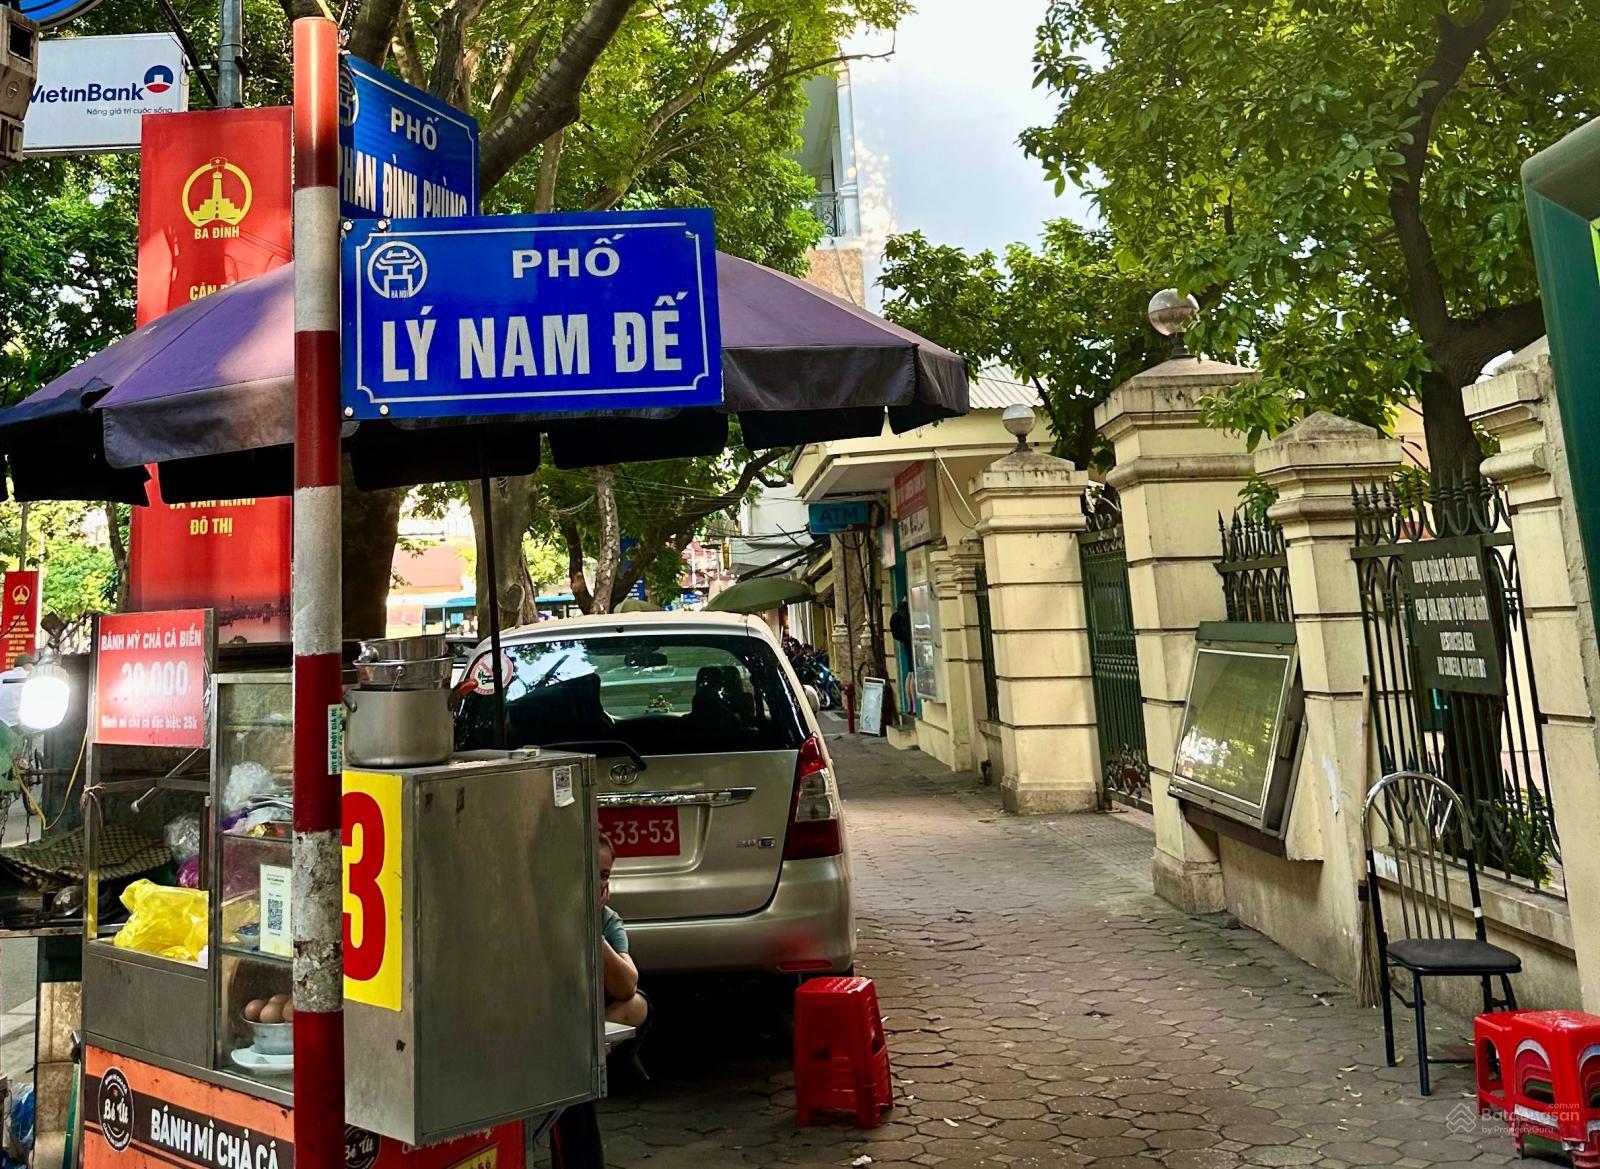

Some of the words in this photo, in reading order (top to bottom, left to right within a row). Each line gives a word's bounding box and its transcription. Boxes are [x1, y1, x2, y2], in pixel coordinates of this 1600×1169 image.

[30, 82, 144, 104] VietinBank
[391, 106, 439, 151] PHỐ
[382, 154, 418, 219] ĐÌNH
[194, 228, 209, 239] BA
[213, 224, 240, 238] ĐÌNH
[512, 233, 624, 279] PHỐ
[382, 305, 437, 383] LÝ
[458, 313, 590, 379] NAM
[612, 291, 688, 373] ĐẾ
[190, 516, 208, 535] ĐÔ
[212, 517, 233, 537] THỊ
[820, 506, 859, 523] ATM
[101, 630, 125, 651] BÁNH
[143, 627, 162, 649] CHẢ
[164, 627, 177, 648] CÁ
[180, 623, 202, 647] BIỂN
[598, 818, 675, 845] -33-53
[342, 792, 386, 981] 3
[151, 1104, 192, 1154] BÁNH
[194, 1119, 215, 1162] MÌ
[217, 1128, 254, 1169] CHẢ
[255, 1139, 280, 1169] CÁ
